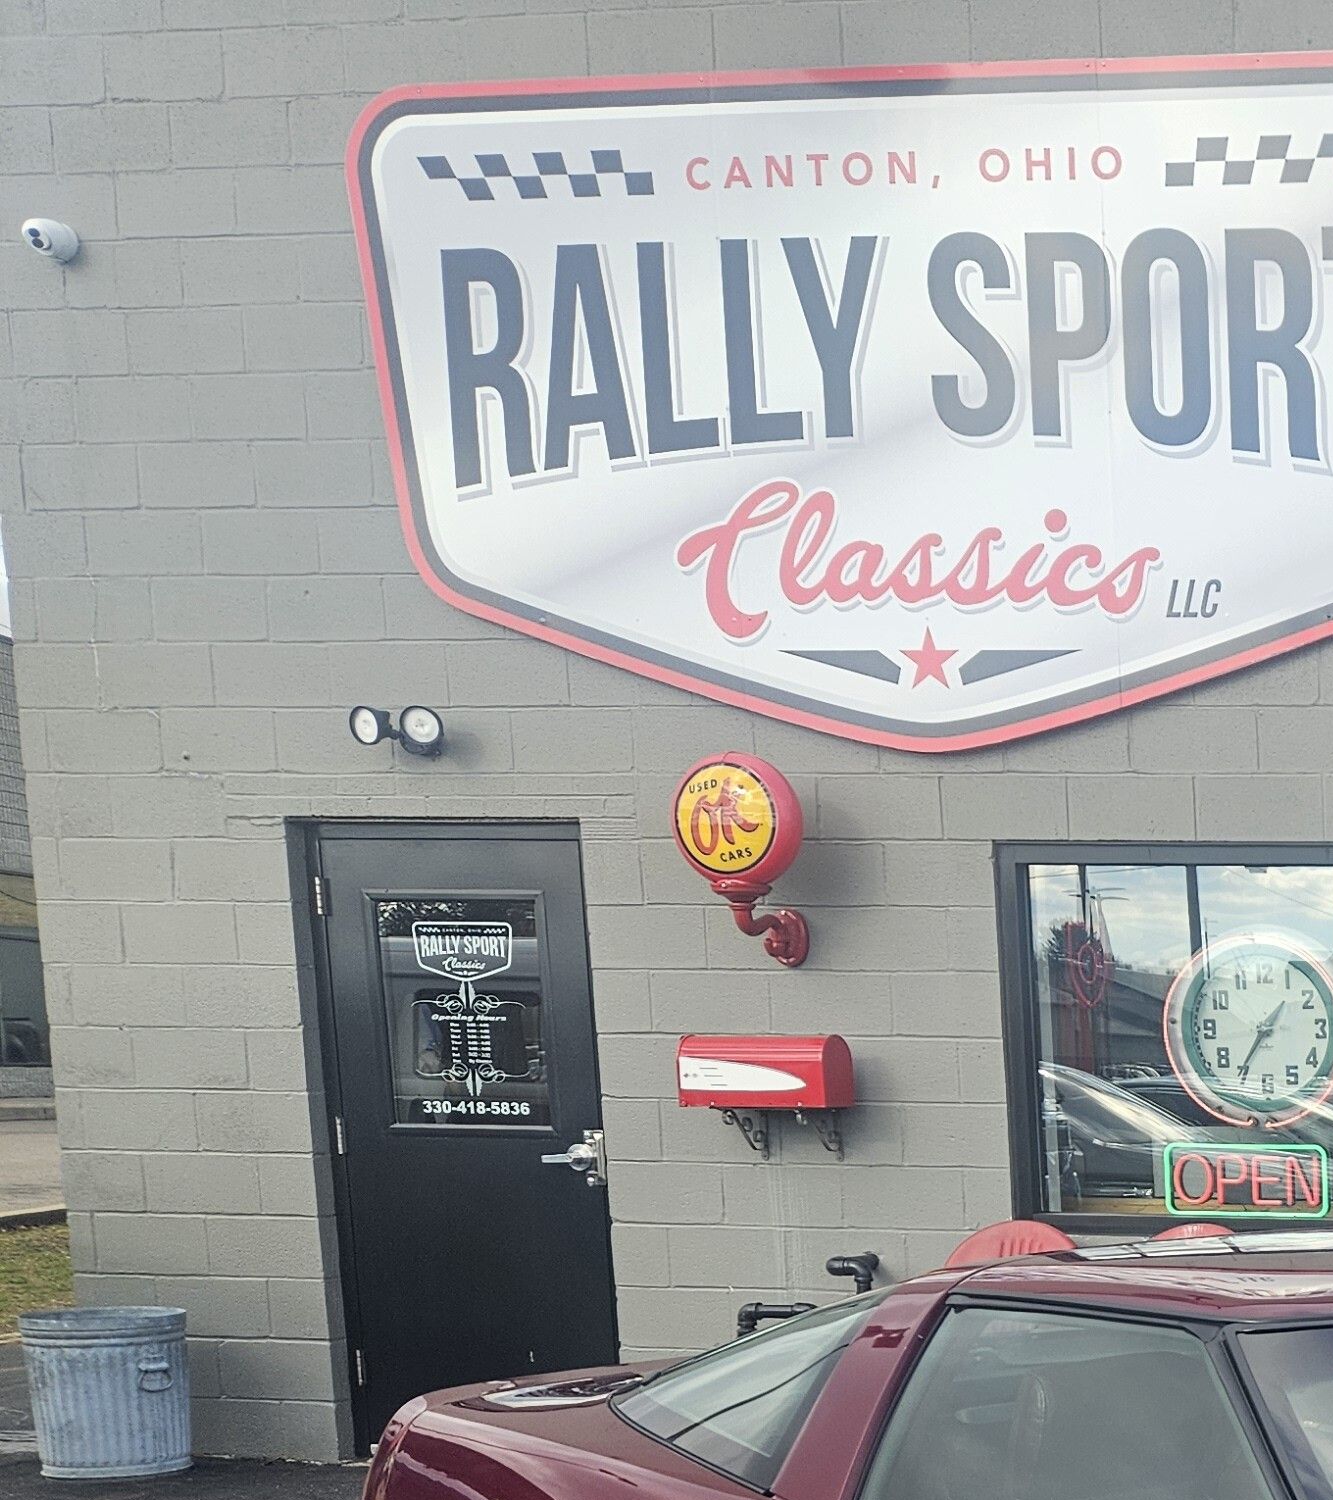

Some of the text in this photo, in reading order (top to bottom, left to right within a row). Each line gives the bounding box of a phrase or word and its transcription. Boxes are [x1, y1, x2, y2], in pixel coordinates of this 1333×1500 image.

[685, 145, 1125, 191] CANTON, OHIO
[439, 234, 886, 498] RALLY
[675, 479, 1162, 641] Classics
[1164, 577, 1223, 620] LLC
[689, 779, 718, 794] USED
[691, 777, 760, 856] OK
[720, 847, 753, 862] CARS
[420, 935, 506, 958] RALLY SPORT
[442, 956, 486, 971] Classics
[1256, 963, 1273, 984] 12
[1235, 970, 1247, 990] 11
[1284, 969, 1290, 990] 1
[1212, 990, 1229, 1010] 10
[1301, 990, 1314, 1010] 2
[431, 1013, 474, 1022] Opening
[1203, 1019, 1216, 1039] 9
[1315, 1018, 1327, 1039] 3
[1217, 1047, 1230, 1068] 8
[1306, 1047, 1318, 1068] 4
[1262, 1074, 1274, 1094] 6
[1286, 1065, 1298, 1085] 5
[423, 1100, 530, 1116] 330-418-5836
[1173, 1153, 1322, 1208] OPEN
